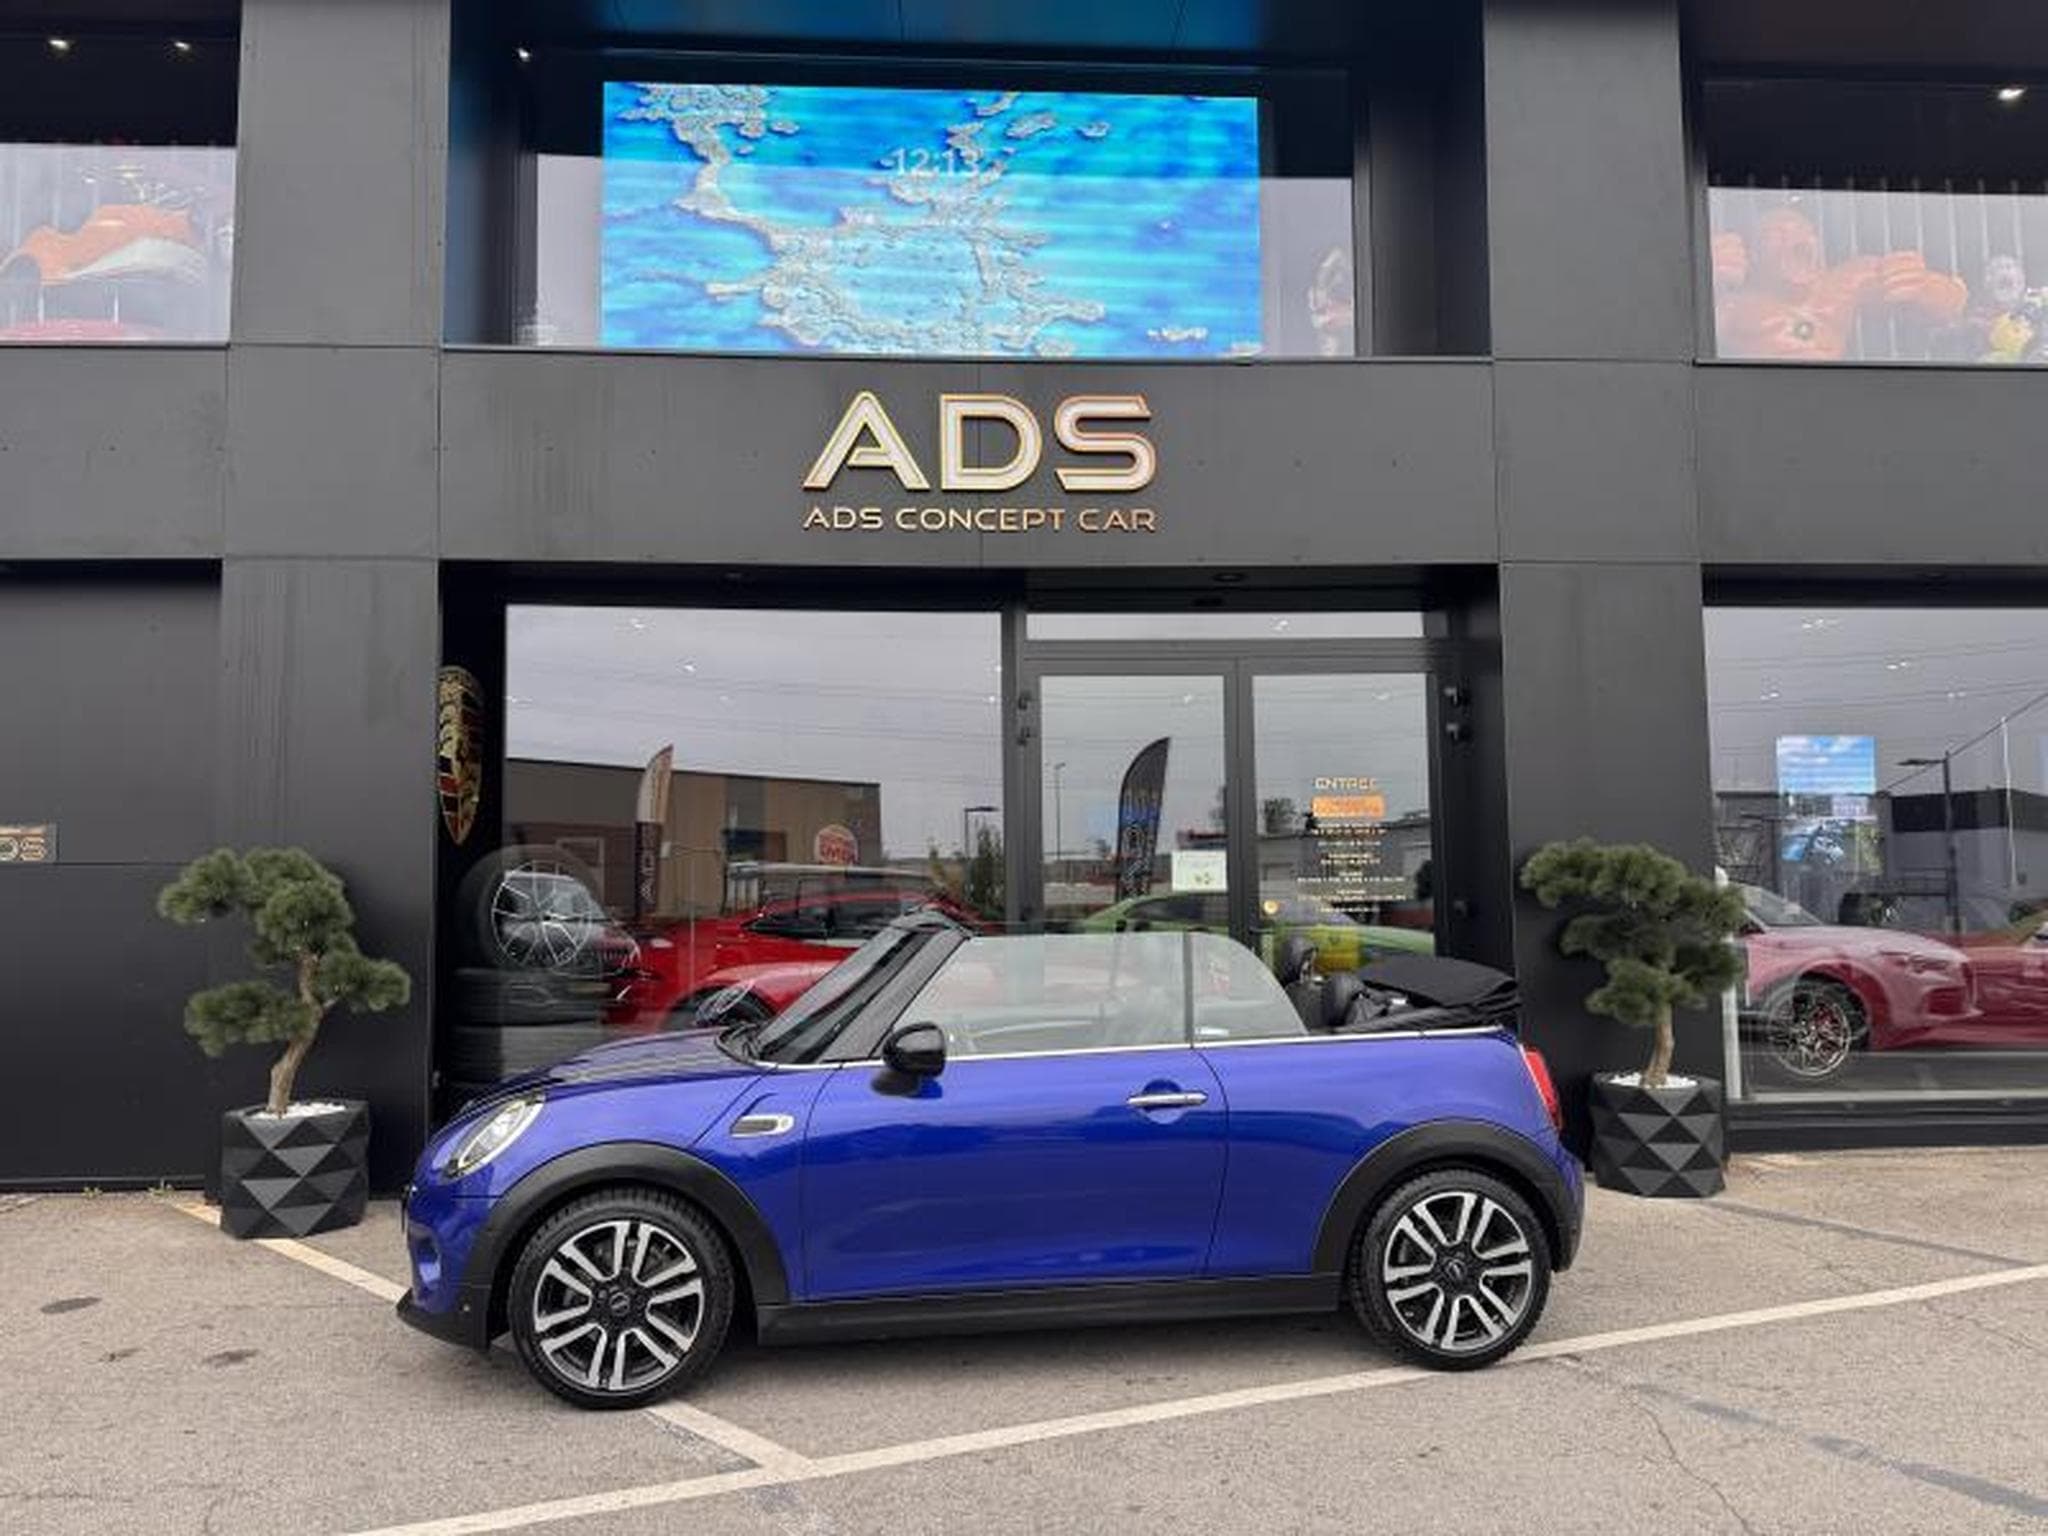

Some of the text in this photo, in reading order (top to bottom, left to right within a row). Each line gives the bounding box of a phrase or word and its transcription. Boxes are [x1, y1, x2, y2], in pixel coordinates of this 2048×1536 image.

[803, 391, 1156, 490] ADS
[803, 508, 1155, 532] ADS CONCEPT CAR
